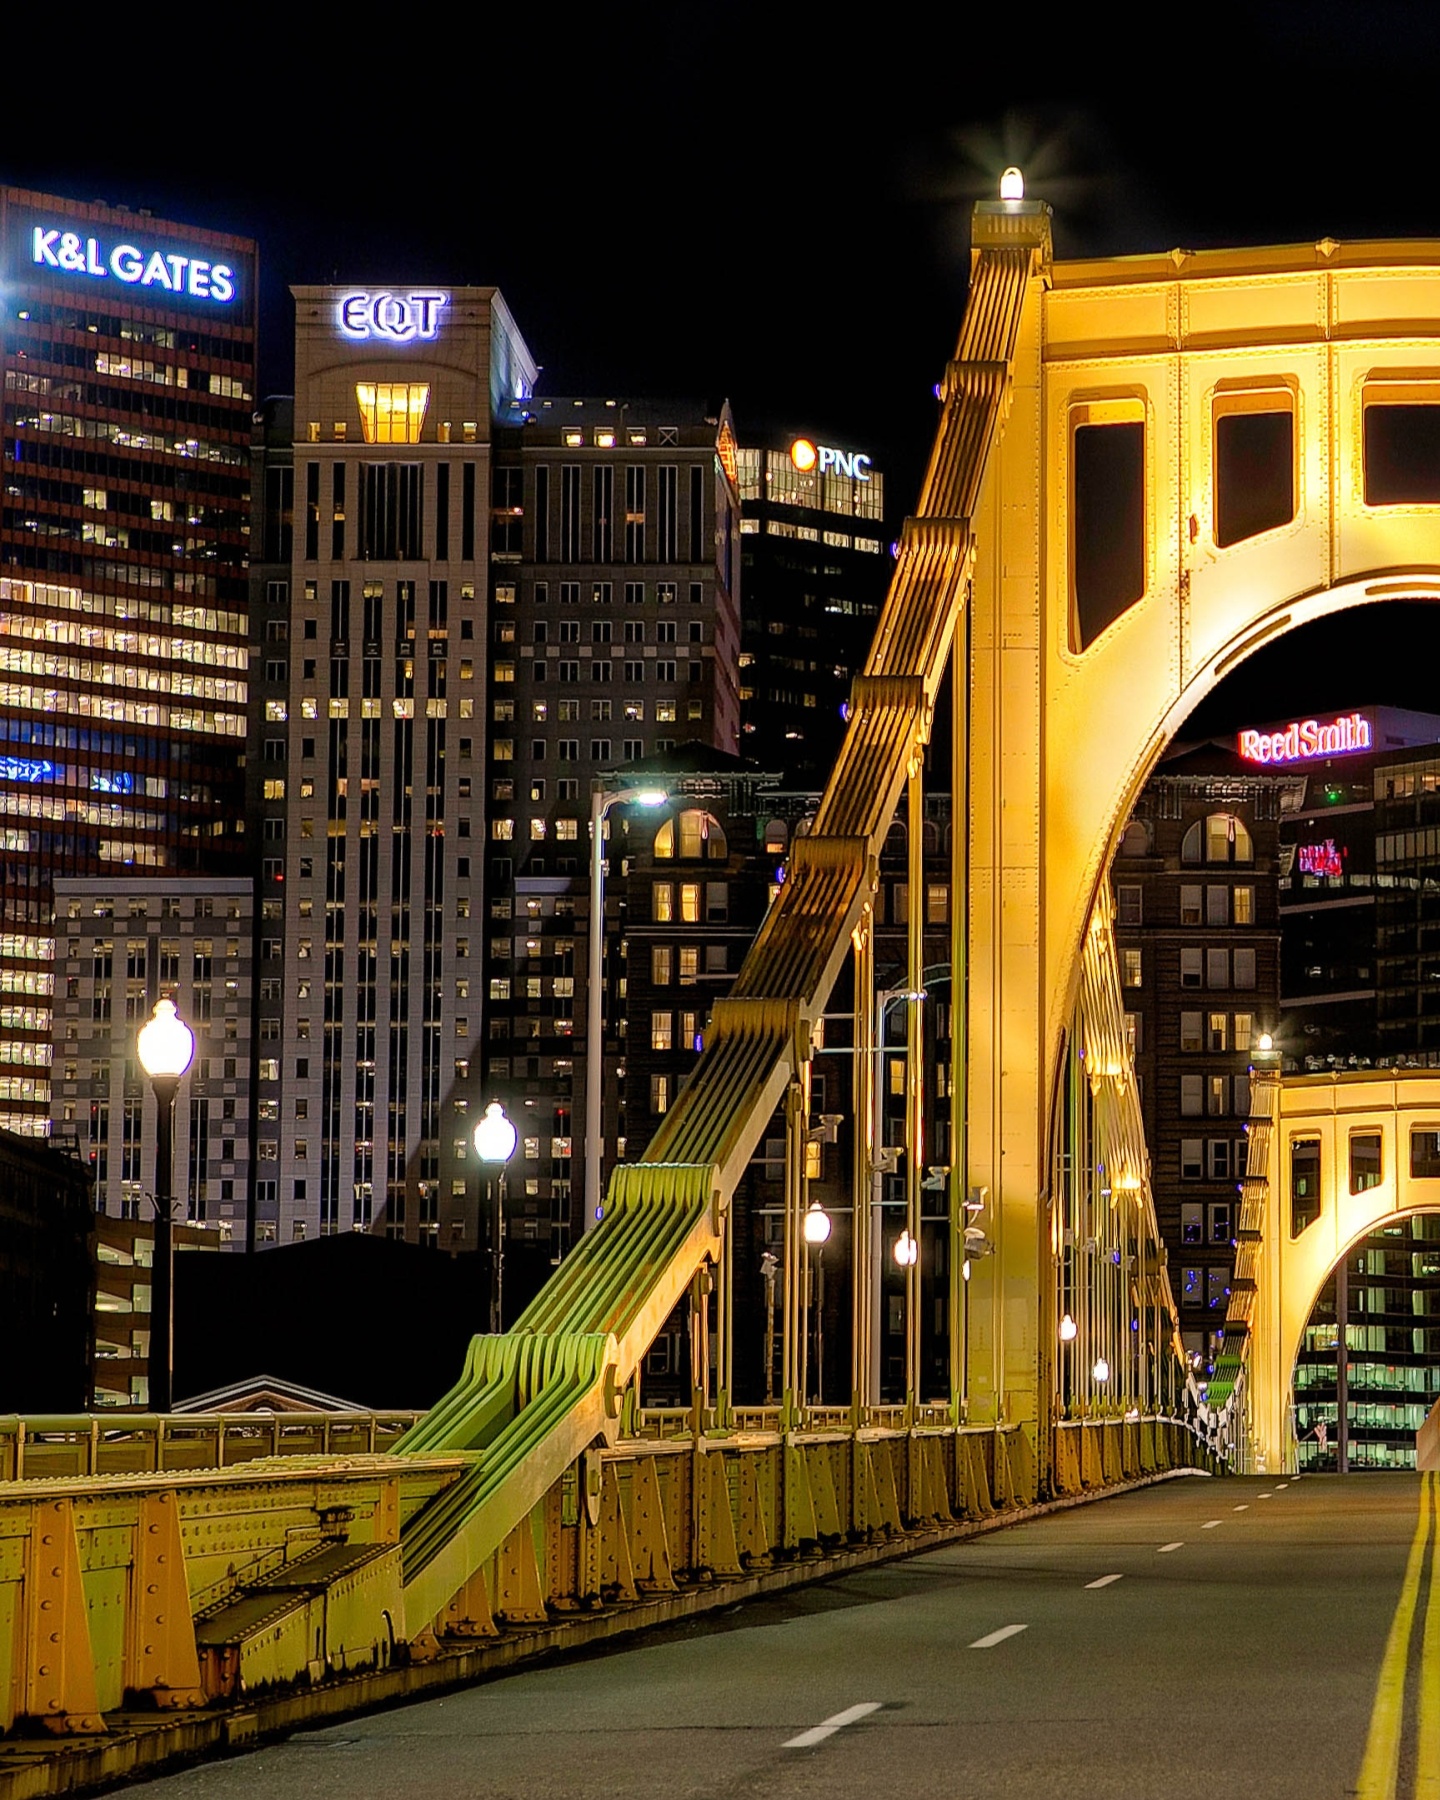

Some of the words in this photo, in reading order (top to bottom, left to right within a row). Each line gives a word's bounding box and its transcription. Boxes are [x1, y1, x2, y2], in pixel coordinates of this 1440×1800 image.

[33, 226, 108, 276] K&L
[109, 244, 235, 302] GATES
[338, 293, 446, 340] EQT
[817, 445, 872, 481] PNC
[1238, 723, 1300, 762] Reed
[1300, 714, 1371, 757] Smith
